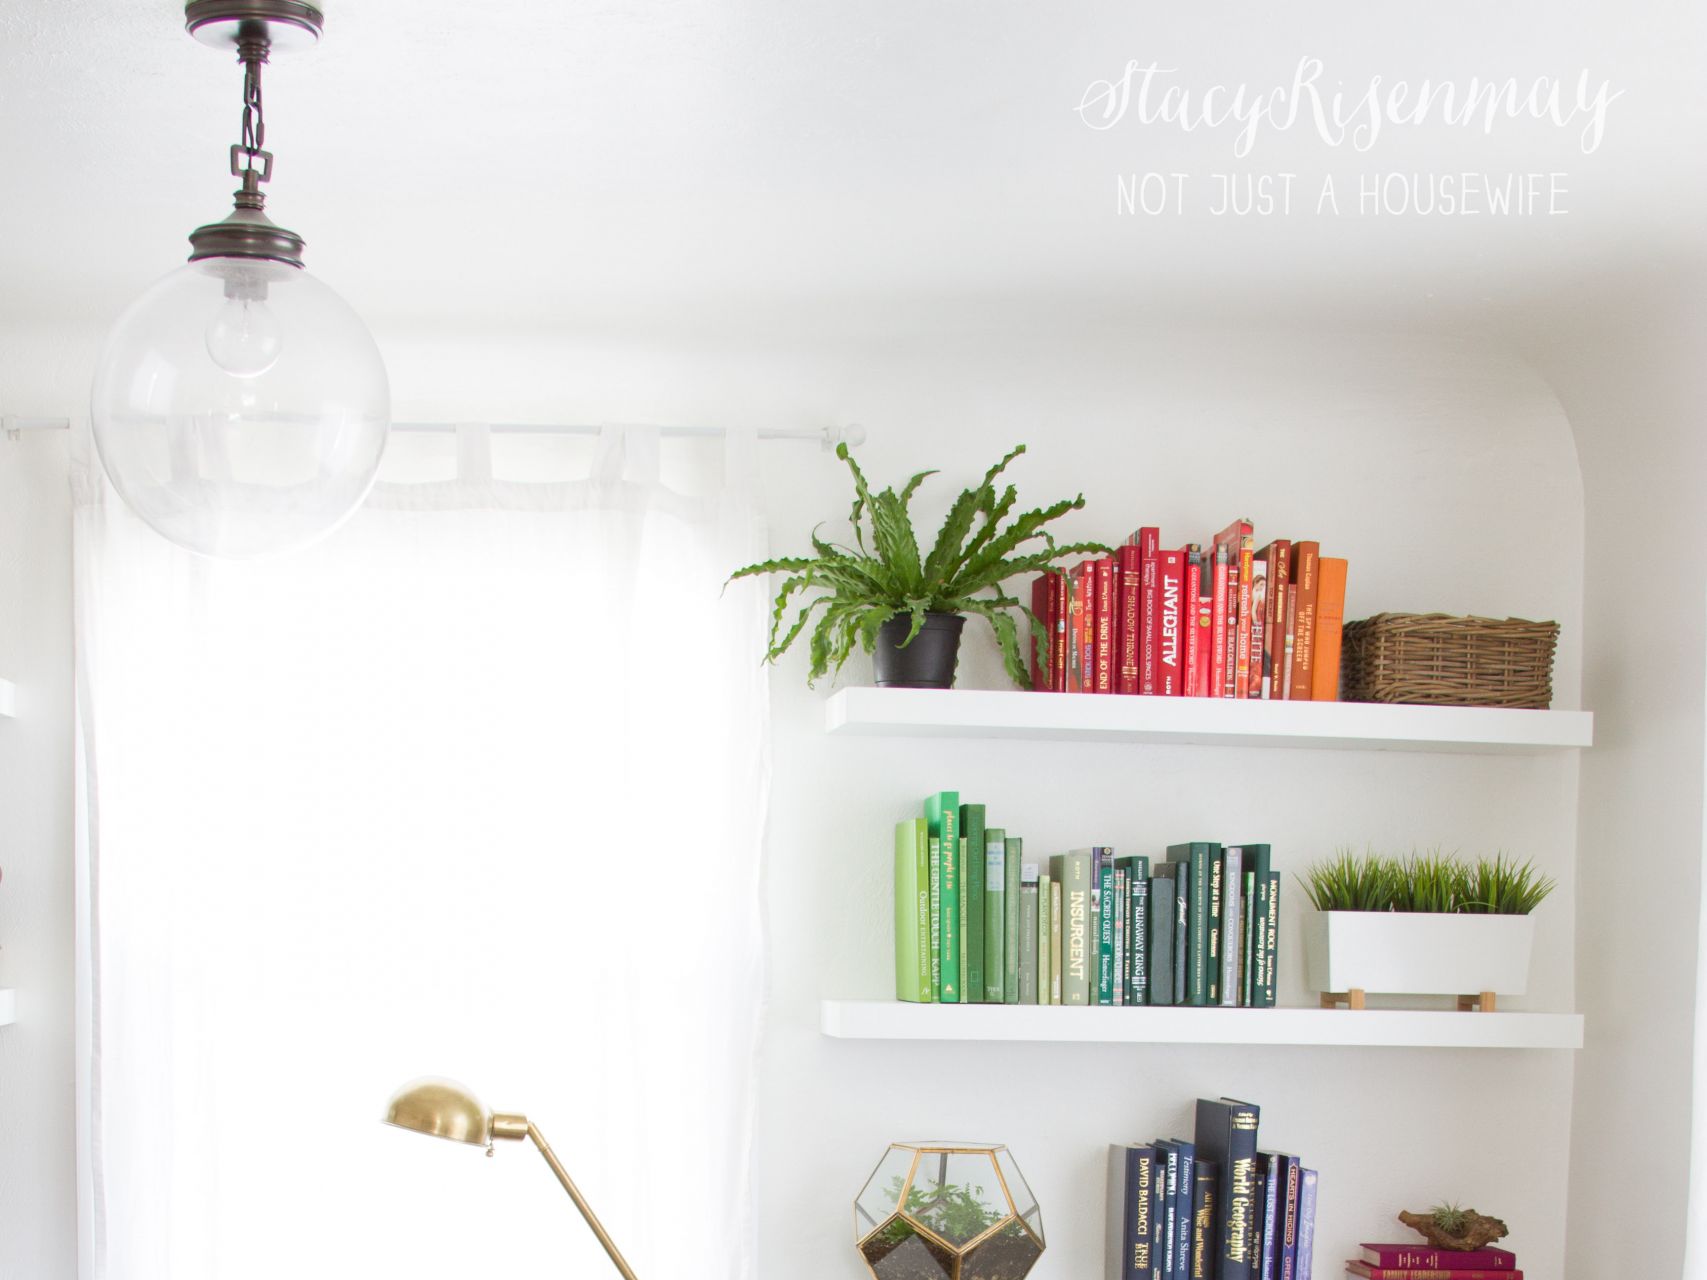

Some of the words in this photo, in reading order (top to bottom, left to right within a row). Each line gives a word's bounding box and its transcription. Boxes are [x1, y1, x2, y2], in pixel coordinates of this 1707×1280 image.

[1164, 575, 1178, 666] ALLEGIANT
[1252, 626, 1263, 663] ELITE
[1101, 660, 1108, 670] OF
[1211, 874, 1220, 888] Step
[920, 891, 928, 925] Outdoor
[1103, 890, 1111, 919] SACRED
[1269, 880, 1277, 926] MONUMENT
[932, 912, 940, 949] TOUCH
[1070, 891, 1084, 980] INSURGENT
[1103, 920, 1111, 944] QUEST
[1136, 906, 1144, 951] RUNAWAY
[1136, 954, 1144, 976] KING
[1139, 1158, 1149, 1187] DAVID
[1182, 1156, 1192, 1195] Testimony
[1233, 1158, 1251, 1194] World
[1289, 1169, 1297, 1200] HEARTS
[1138, 1190, 1148, 1235] BALDACCI
[1289, 1203, 1295, 1212] IN
[1181, 1217, 1189, 1240] Anita
[1227, 1197, 1251, 1263] Geography
[1180, 1242, 1188, 1271] Shreve
